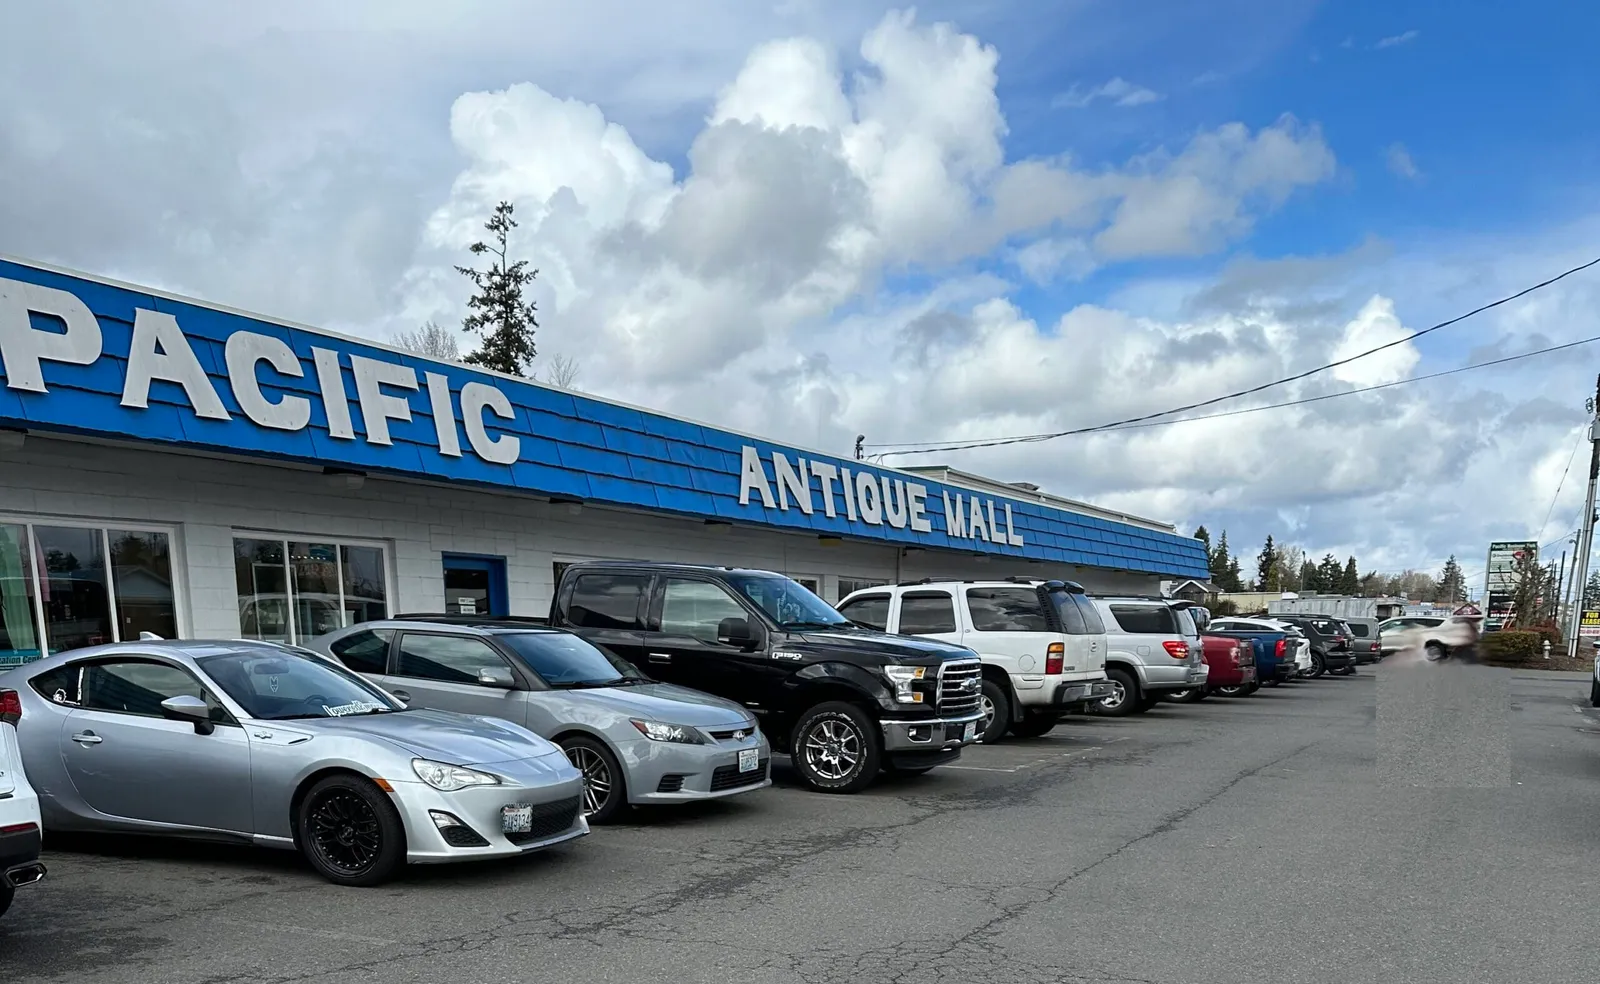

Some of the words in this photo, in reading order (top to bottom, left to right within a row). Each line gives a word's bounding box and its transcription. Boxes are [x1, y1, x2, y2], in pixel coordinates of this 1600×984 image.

[0, 277, 521, 465] PACIFIC
[739, 445, 933, 533] ANTIQUE
[942, 489, 1024, 547] MALL
